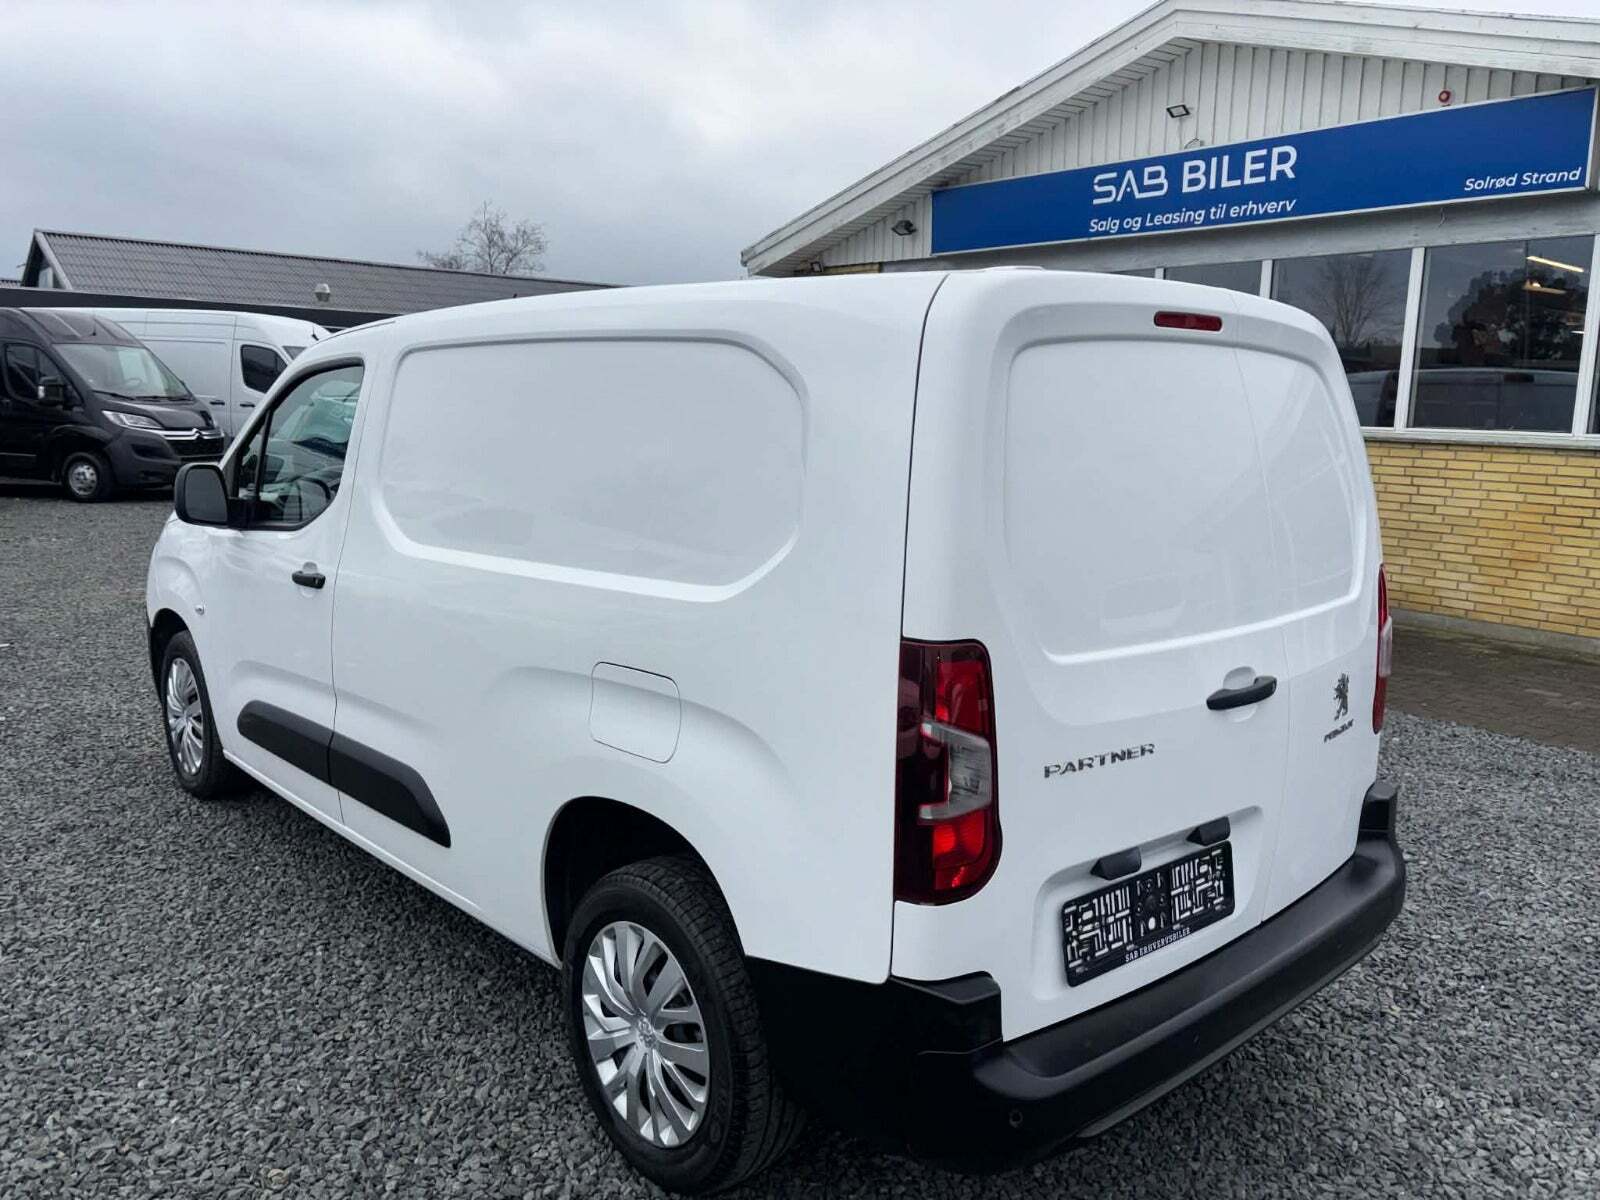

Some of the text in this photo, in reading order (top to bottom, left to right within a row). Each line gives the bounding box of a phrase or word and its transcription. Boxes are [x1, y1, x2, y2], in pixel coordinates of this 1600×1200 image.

[1093, 145, 1298, 205] SAB BILER
[1464, 167, 1581, 191] Solrød Strand
[1089, 199, 1297, 233] Salg og Leasing til erhverv
[1044, 743, 1155, 778] PARTNER
[1125, 950, 1139, 962] SAB
